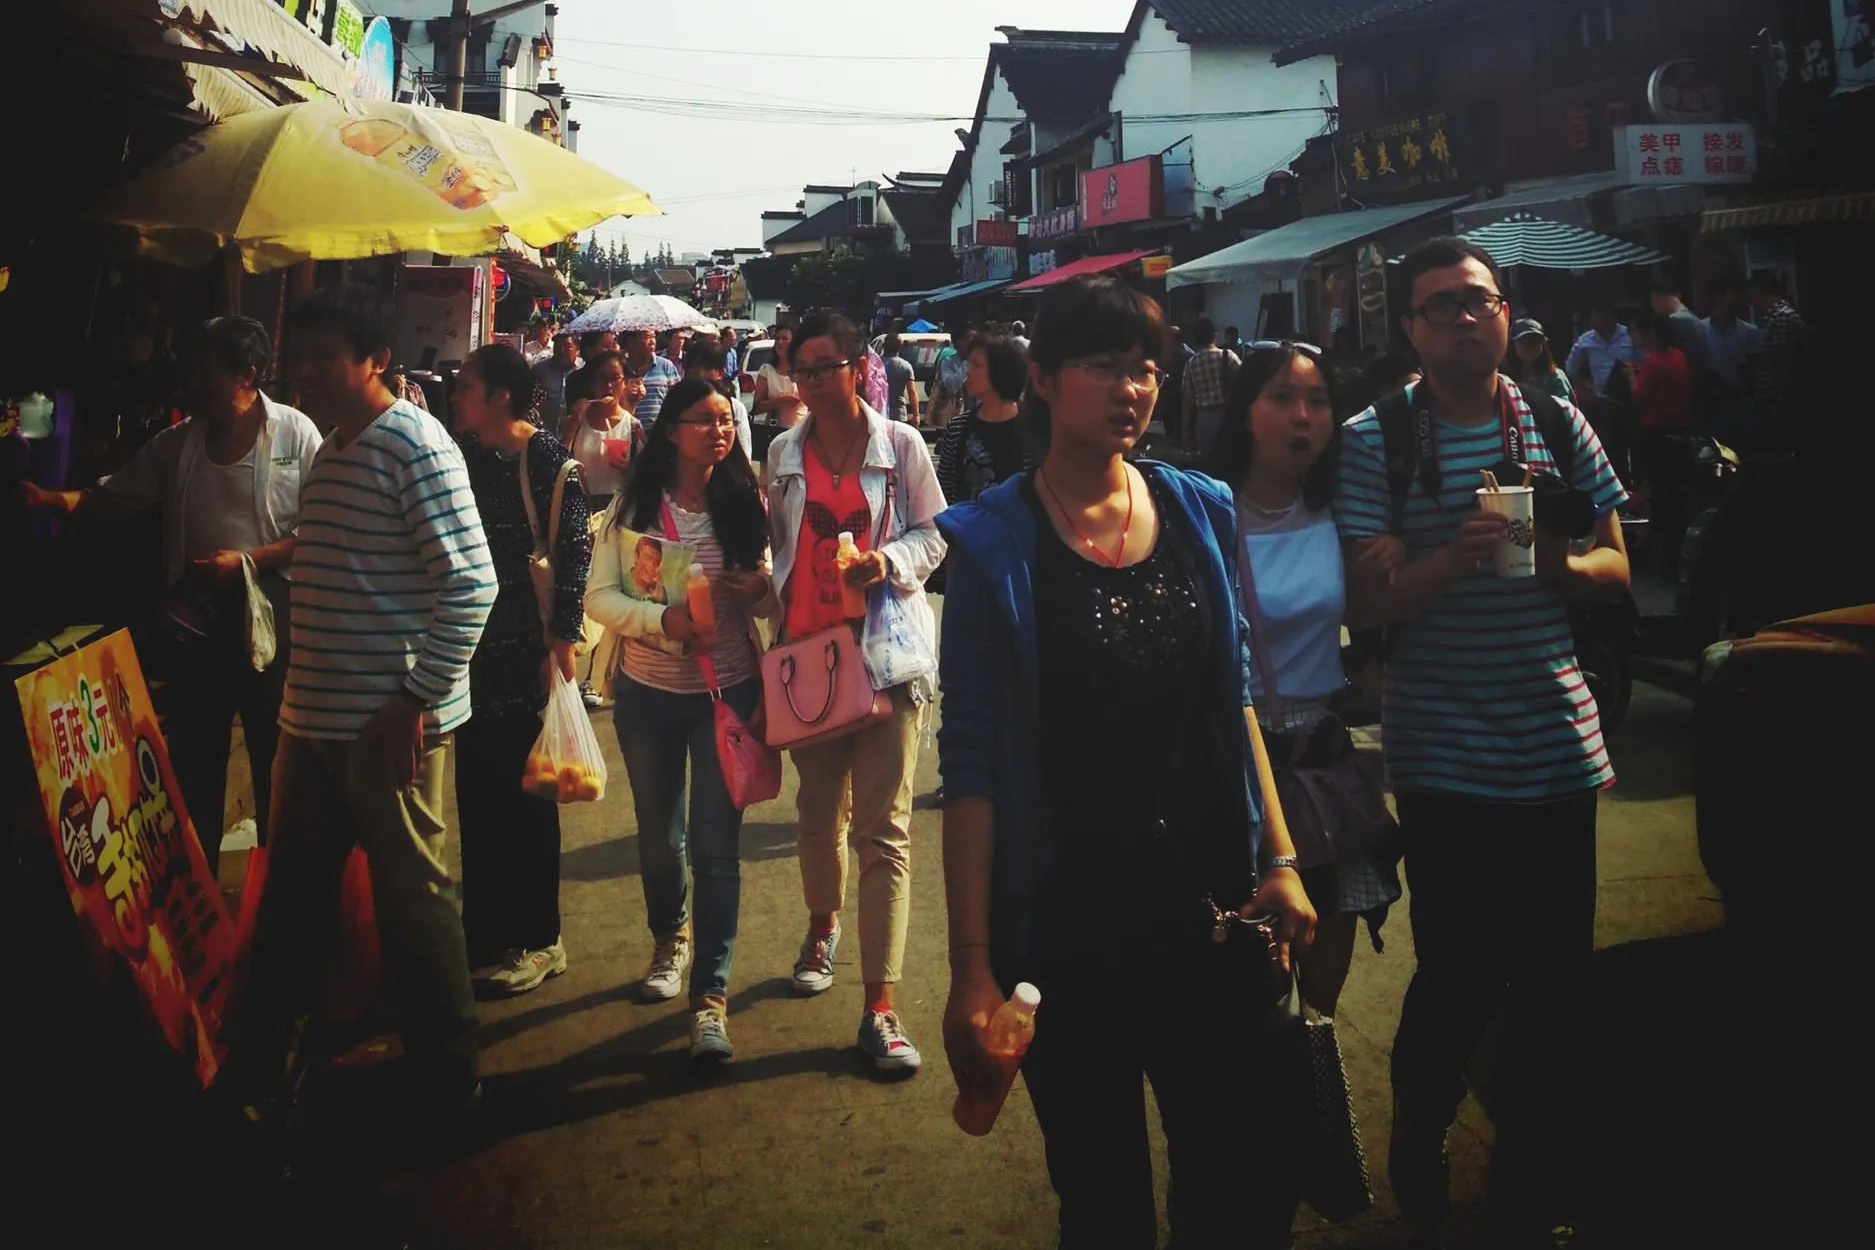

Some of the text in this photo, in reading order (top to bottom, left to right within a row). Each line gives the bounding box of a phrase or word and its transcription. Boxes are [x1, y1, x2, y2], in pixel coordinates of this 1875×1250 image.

[1639, 131, 1745, 153] 美甲 接发
[1641, 155, 1684, 176] 点痣
[1418, 408, 1430, 437] EOS
[60, 816, 96, 880] 台湾
